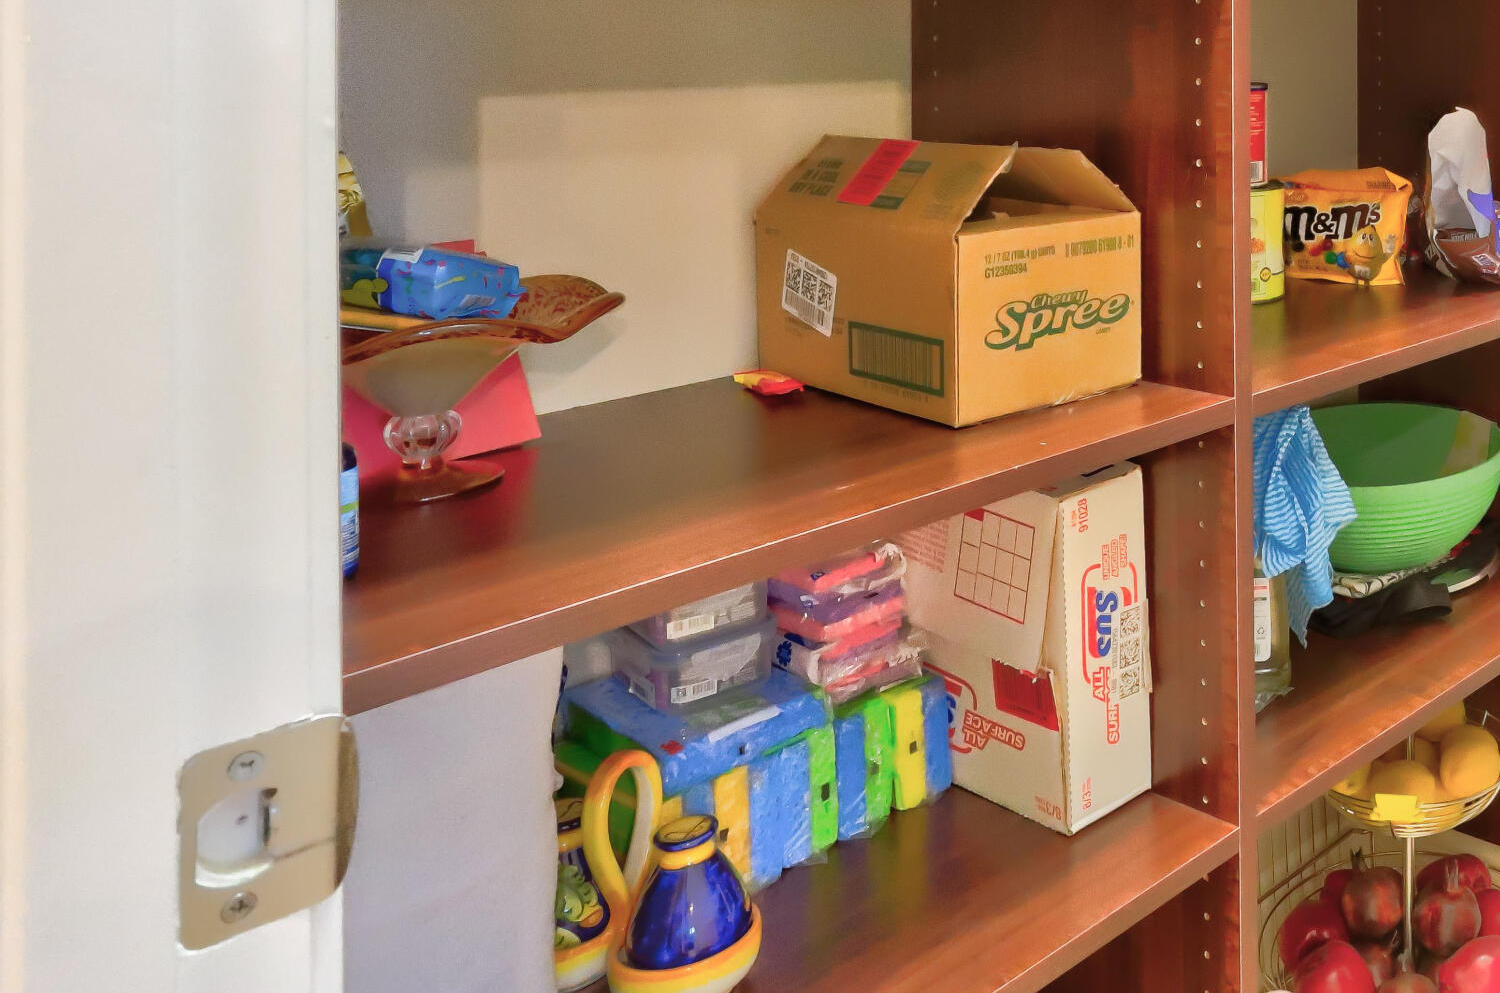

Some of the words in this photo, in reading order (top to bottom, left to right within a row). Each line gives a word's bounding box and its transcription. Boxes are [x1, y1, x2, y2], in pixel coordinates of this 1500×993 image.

[1031, 290, 1088, 311] Chewy
[985, 294, 1131, 351] Spree
[1077, 498, 1089, 533] 91028
[1102, 544, 1110, 581] UNIQUE
[1093, 667, 1105, 701] ALL
[964, 711, 1025, 751] SURFACE
[965, 728, 987, 750] ALL
